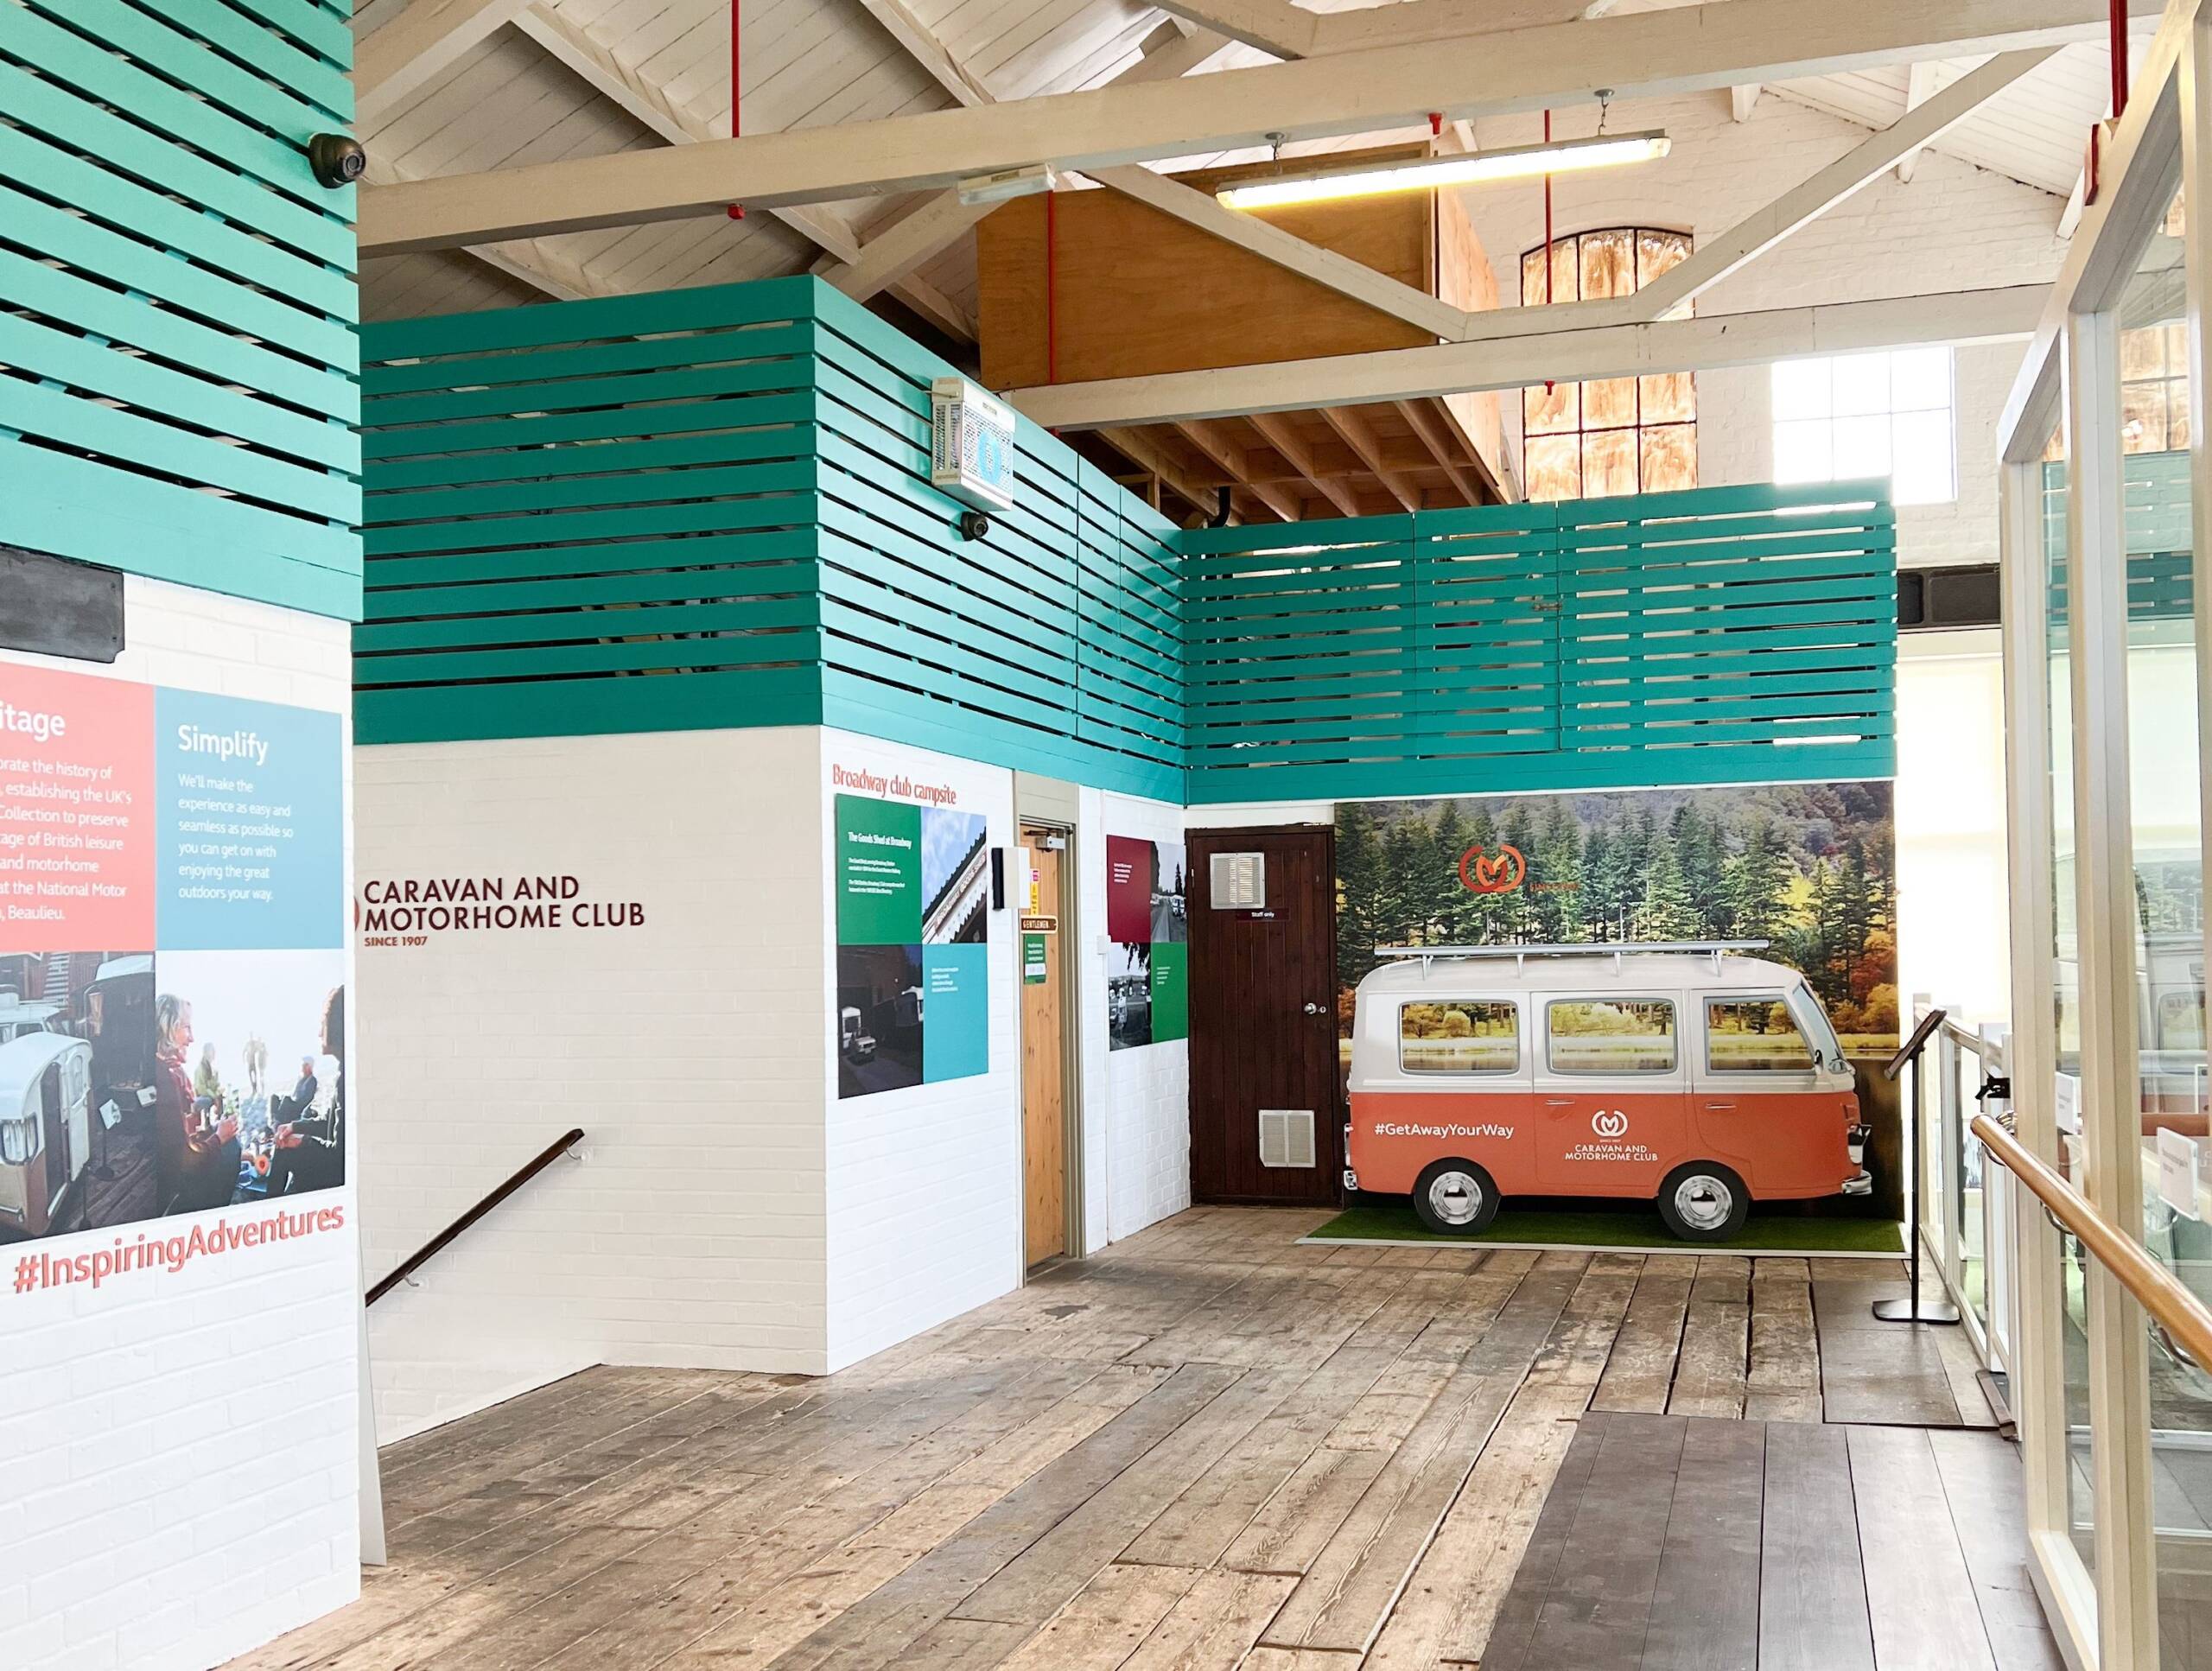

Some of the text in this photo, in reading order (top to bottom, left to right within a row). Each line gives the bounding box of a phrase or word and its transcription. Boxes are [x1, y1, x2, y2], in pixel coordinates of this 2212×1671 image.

[0, 700, 66, 742] itage
[178, 724, 269, 766] Simplify
[32, 759, 54, 774] the
[56, 761, 98, 781] history
[100, 766, 112, 778] of
[5, 781, 79, 804] establishing
[83, 785, 103, 802] the
[105, 790, 132, 804] UK's
[178, 773, 254, 793] We'll make the
[832, 763, 957, 806] Broadway club campsite
[178, 797, 291, 819] experience as easy and
[62, 810, 76, 823] to
[79, 813, 130, 827] preserve
[178, 819, 295, 838] seamless as possible so
[0, 831, 124, 850] age of British leisure
[178, 842, 277, 859] you can get on with
[27, 855, 99, 873] motorhome
[178, 862, 270, 882] enjoying the great
[13, 880, 35, 895] the
[37, 880, 89, 897] National
[92, 882, 127, 898] Motor
[178, 885, 274, 903] outdoors your way.
[364, 875, 579, 905] CARAVAN AND
[8, 905, 66, 921] Beaulieu.
[364, 902, 645, 932] MOTORHOME CLUB
[364, 936, 429, 947] SINCE 1907
[1375, 1123, 1515, 1140] #GetAwayYourWay
[1565, 1153, 1659, 1161] MOTORHOME CLUB
[1574, 1144, 1648, 1153] CARAVAN AND
[14, 1205, 345, 1294] #InspiringAdventures
